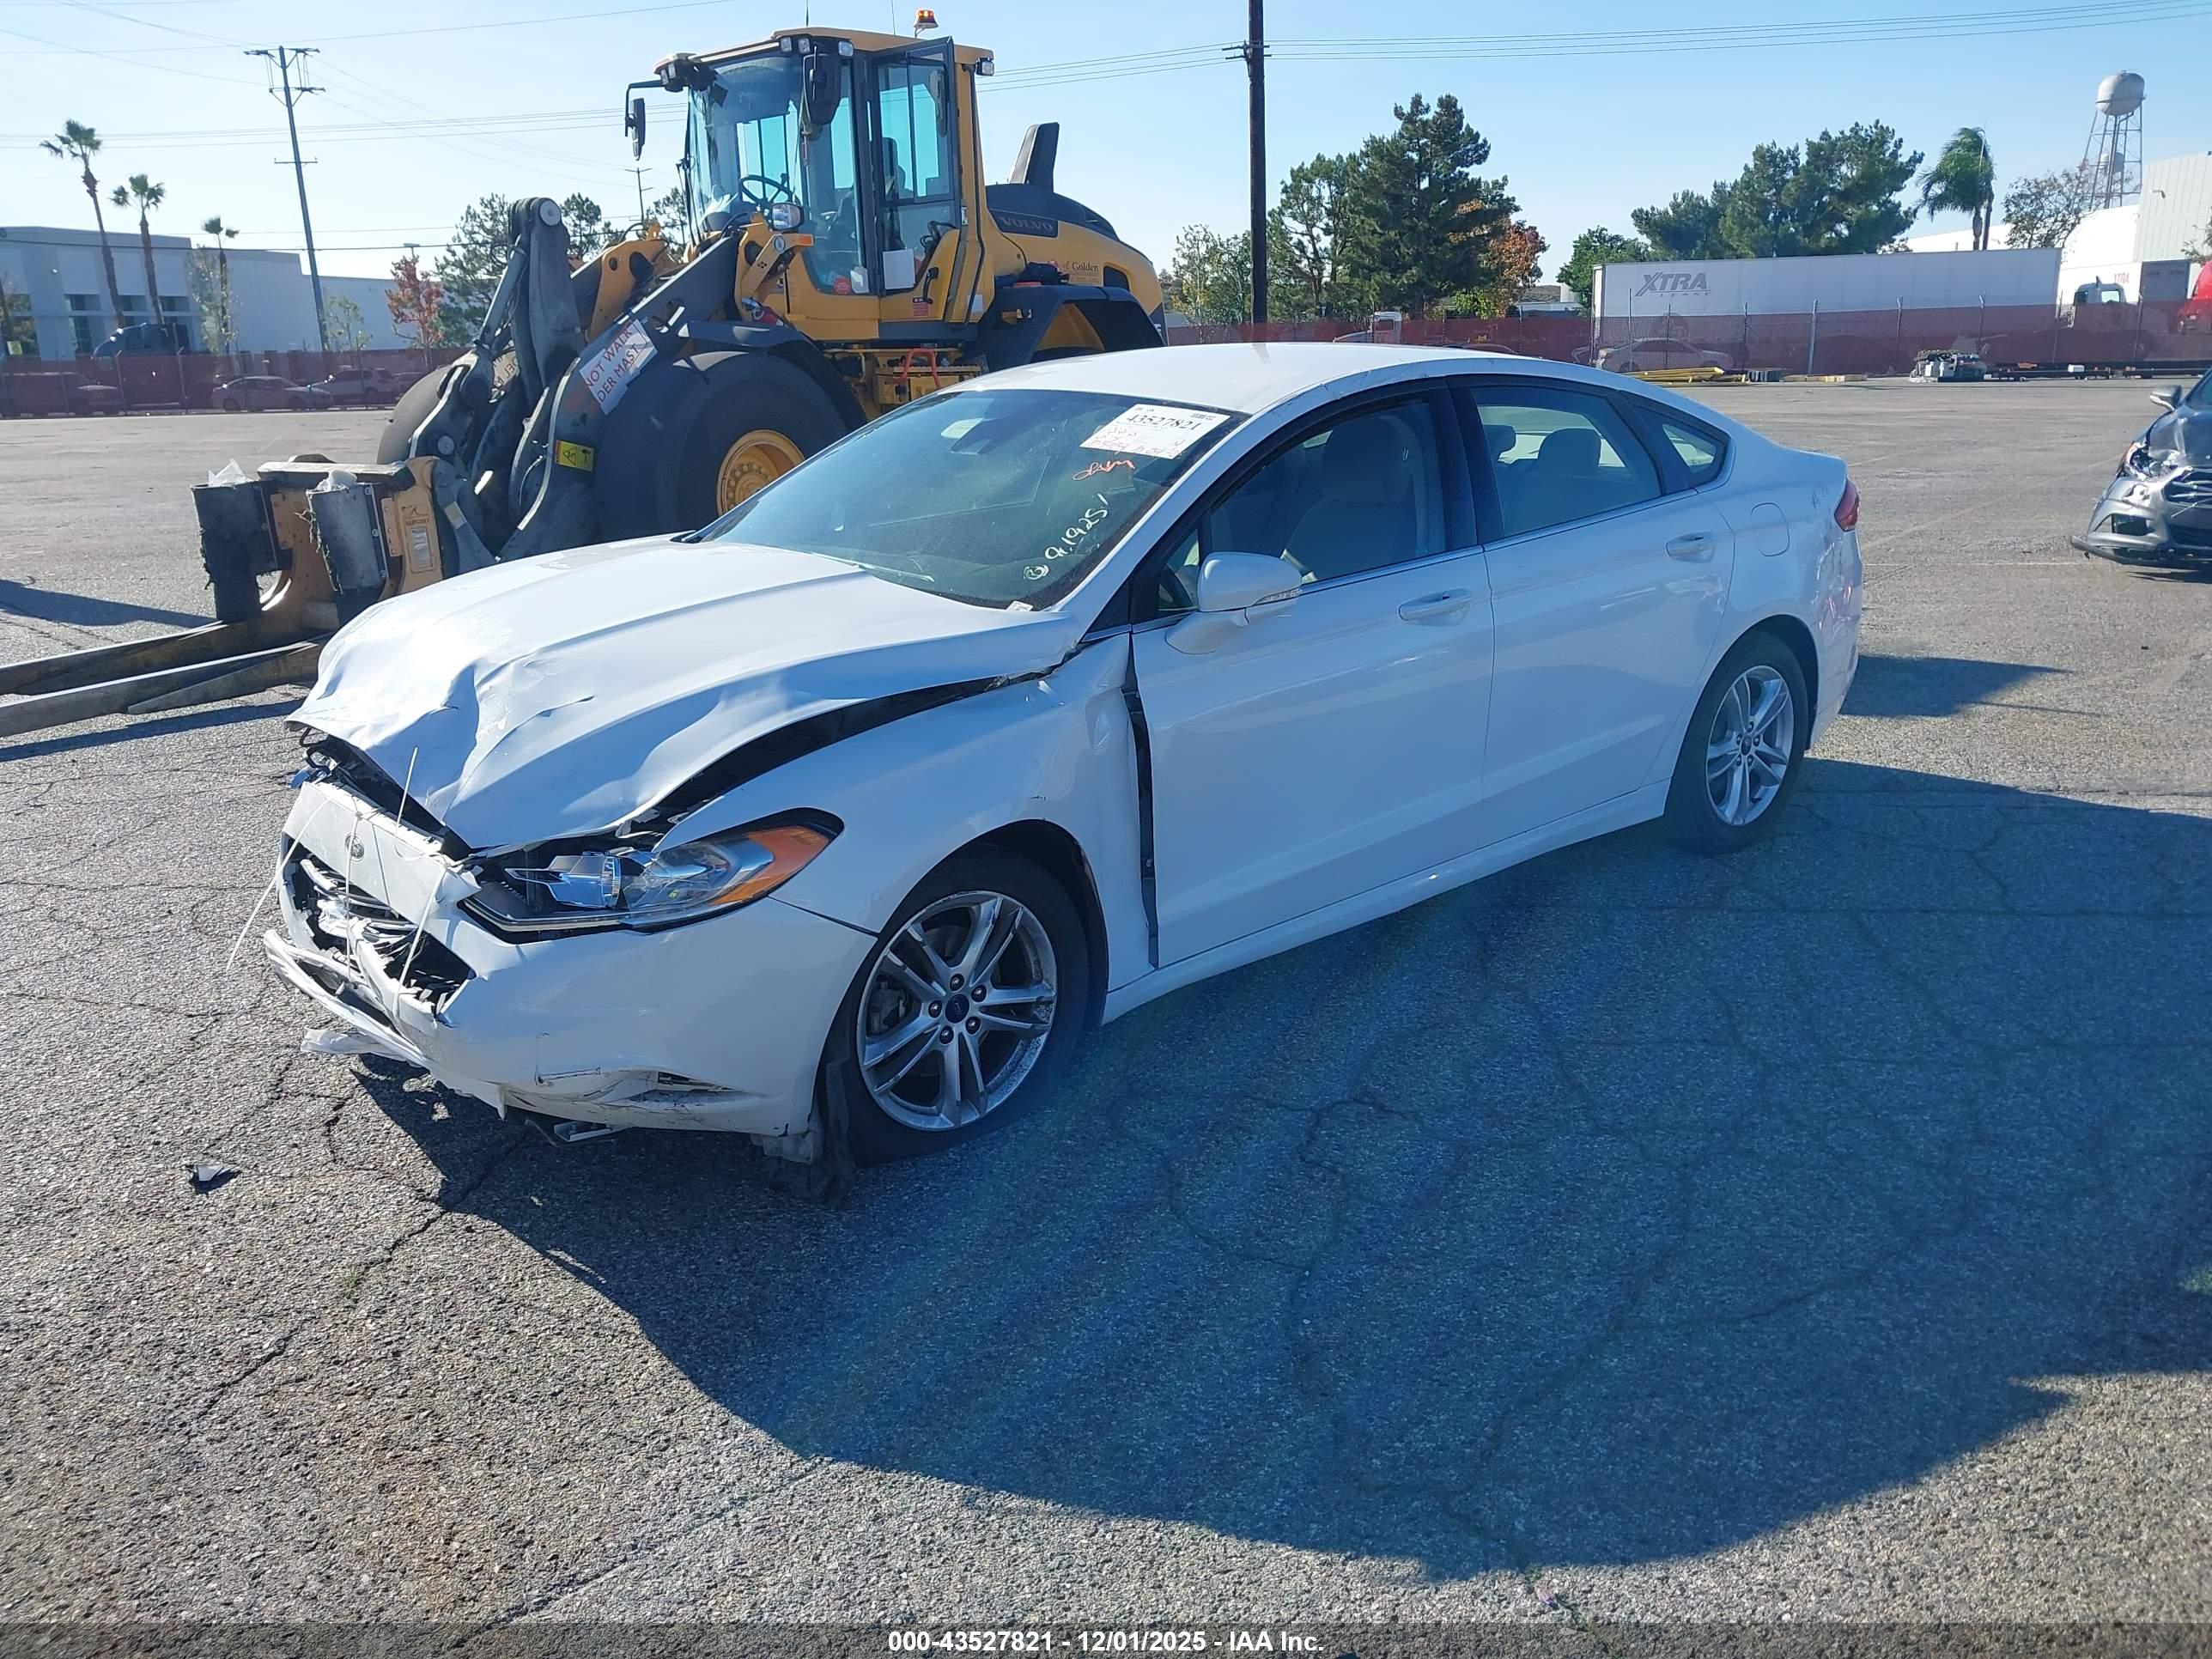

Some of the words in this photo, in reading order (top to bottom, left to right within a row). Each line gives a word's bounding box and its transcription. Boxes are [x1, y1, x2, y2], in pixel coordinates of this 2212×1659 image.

[998, 216, 1054, 232] VOLVO
[1072, 261, 1099, 273] Golden
[1635, 271, 1707, 296] XTRA
[603, 328, 633, 362] WALK
[597, 377, 617, 403] DER
[613, 343, 640, 378] MAST
[1127, 414, 1202, 431] 43527821
